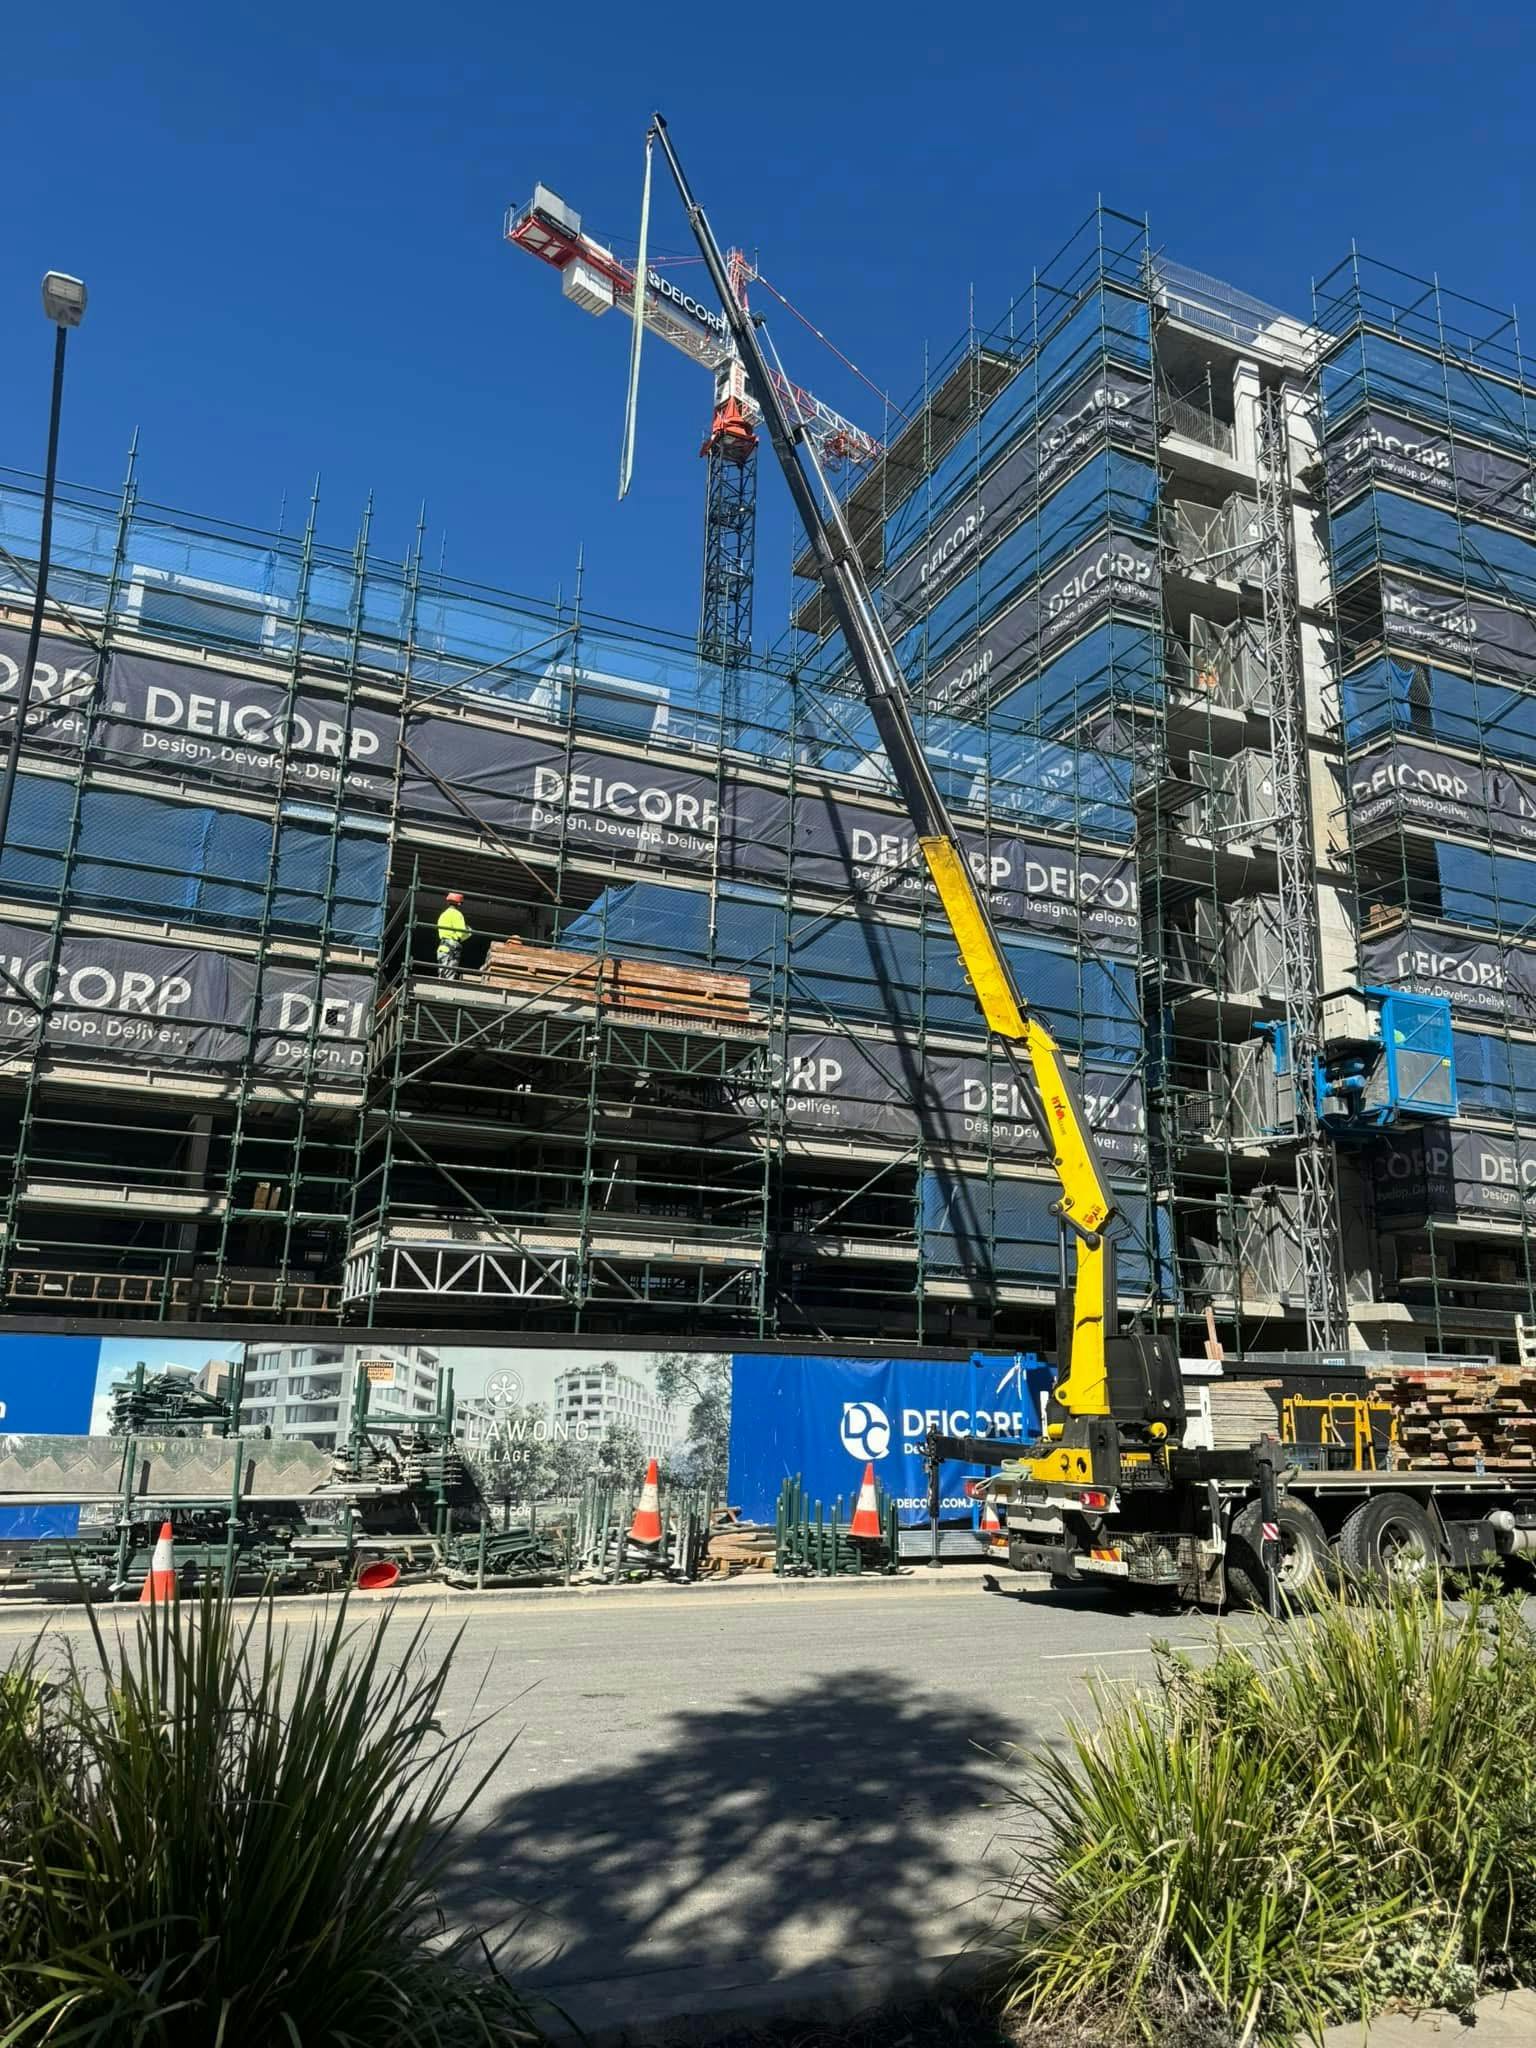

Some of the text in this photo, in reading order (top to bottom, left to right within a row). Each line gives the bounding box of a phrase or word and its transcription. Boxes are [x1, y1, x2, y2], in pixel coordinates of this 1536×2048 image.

[660, 278, 726, 331] DEICORP
[145, 686, 379, 758] DEICORP
[143, 732, 216, 759] Design.
[305, 763, 375, 790] Deliver.
[1352, 763, 1468, 801] DEICORP
[532, 808, 715, 851] Desgn. Develop. Delive
[7, 1009, 184, 1045] Deelop. Deliver.
[786, 1097, 841, 1115] Deliver.
[964, 1118, 1011, 1138] Desgn.
[467, 1450, 531, 1463] VILLAGE
